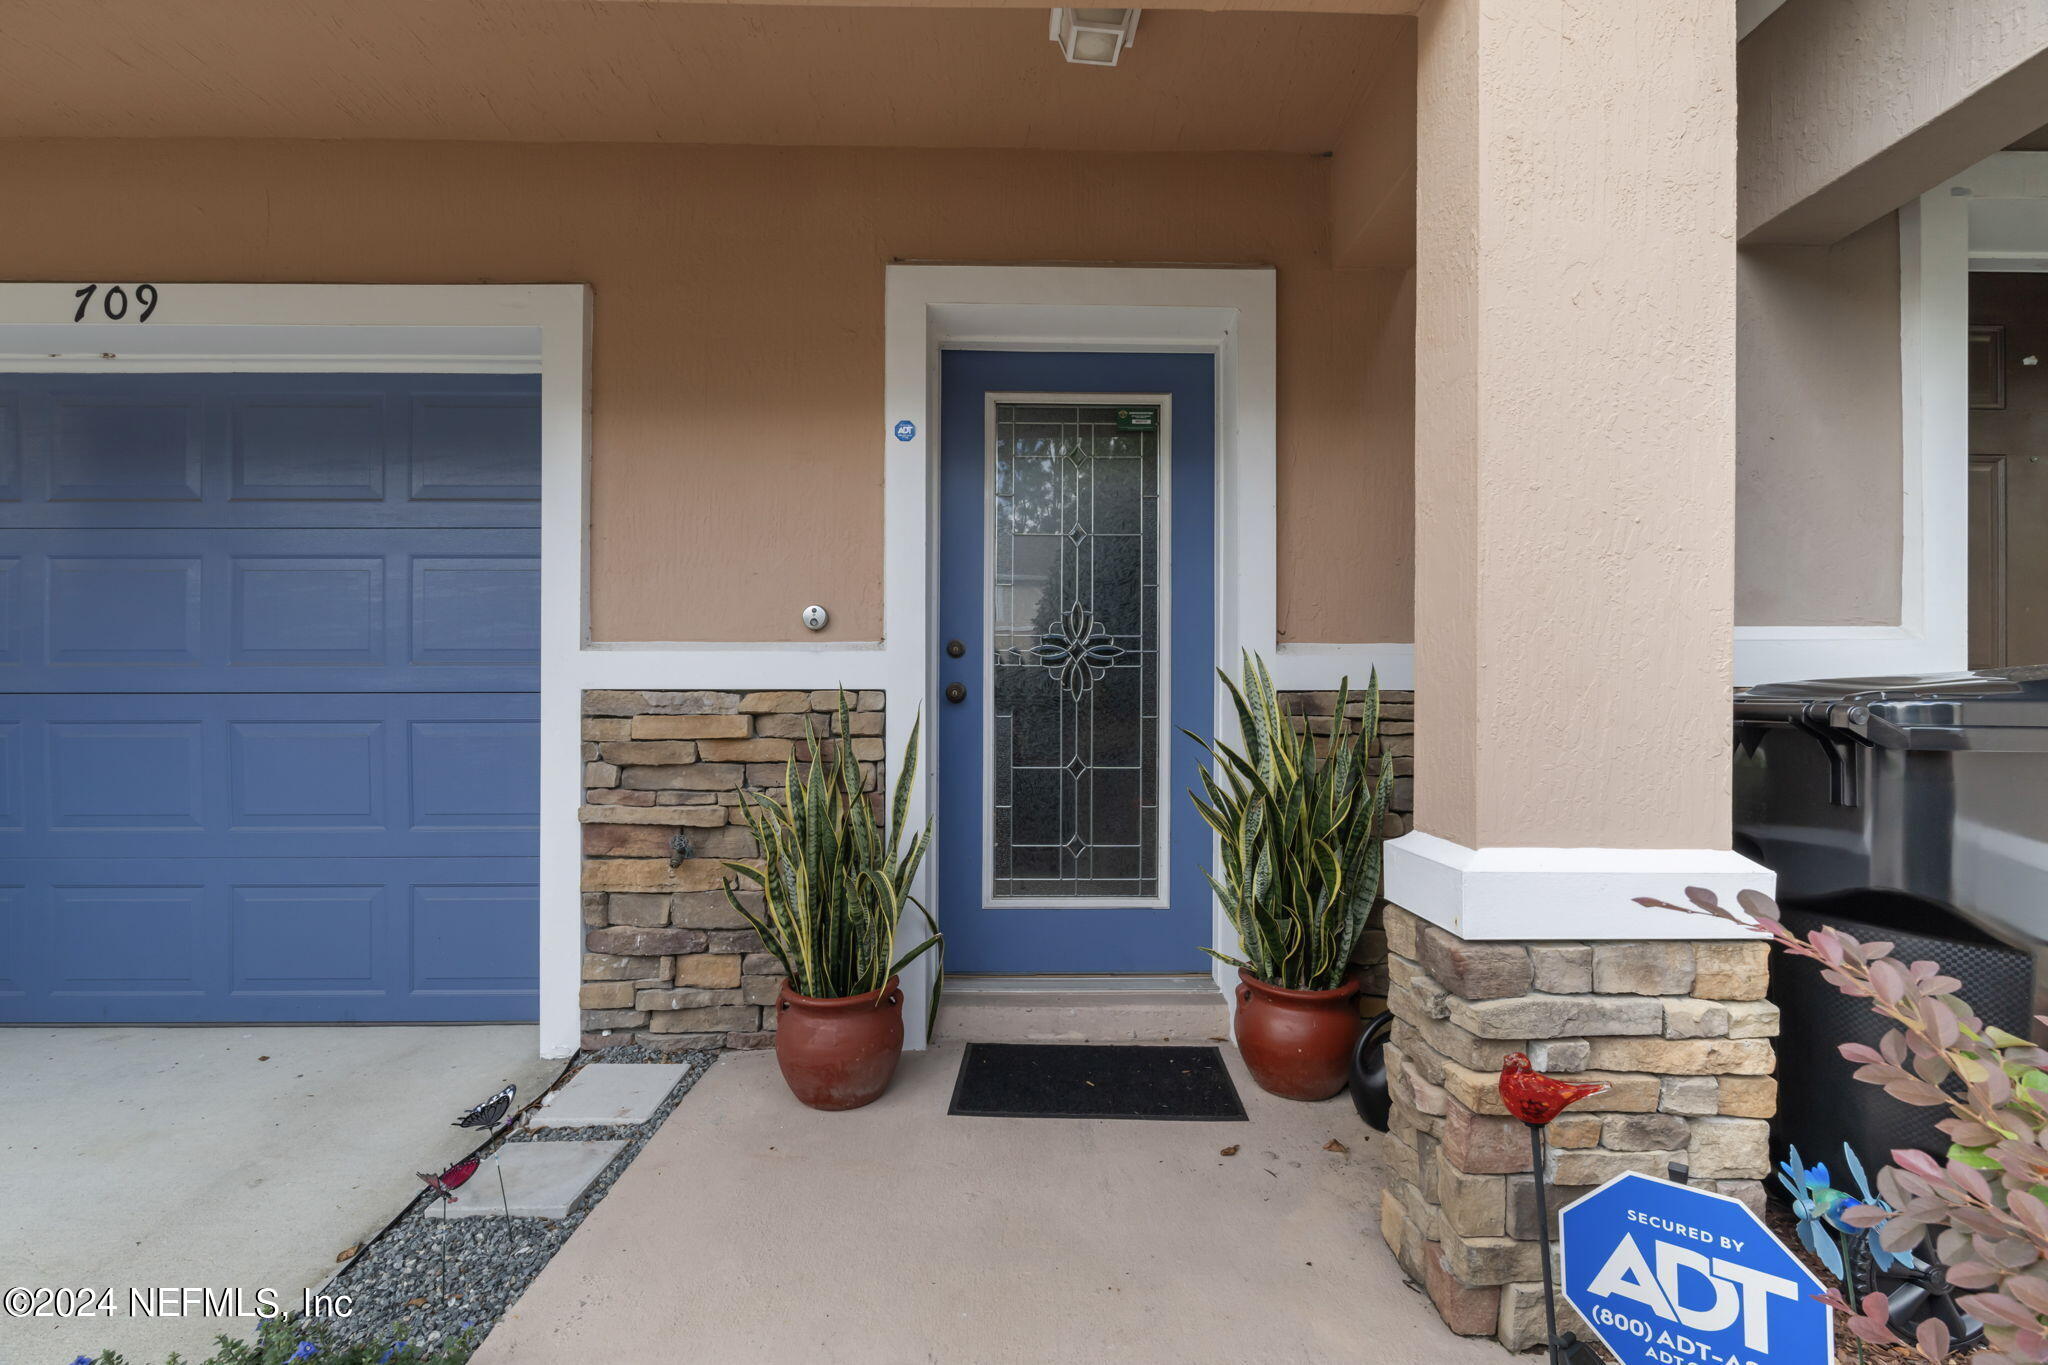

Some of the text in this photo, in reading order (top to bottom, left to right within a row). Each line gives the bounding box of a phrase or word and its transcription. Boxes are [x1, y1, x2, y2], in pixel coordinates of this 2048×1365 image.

[897, 426, 914, 435] ADT
[1627, 1209, 1745, 1253] SECURED BY
[1587, 1231, 1799, 1355] ADT
[1592, 1304, 1653, 1343] (800)
